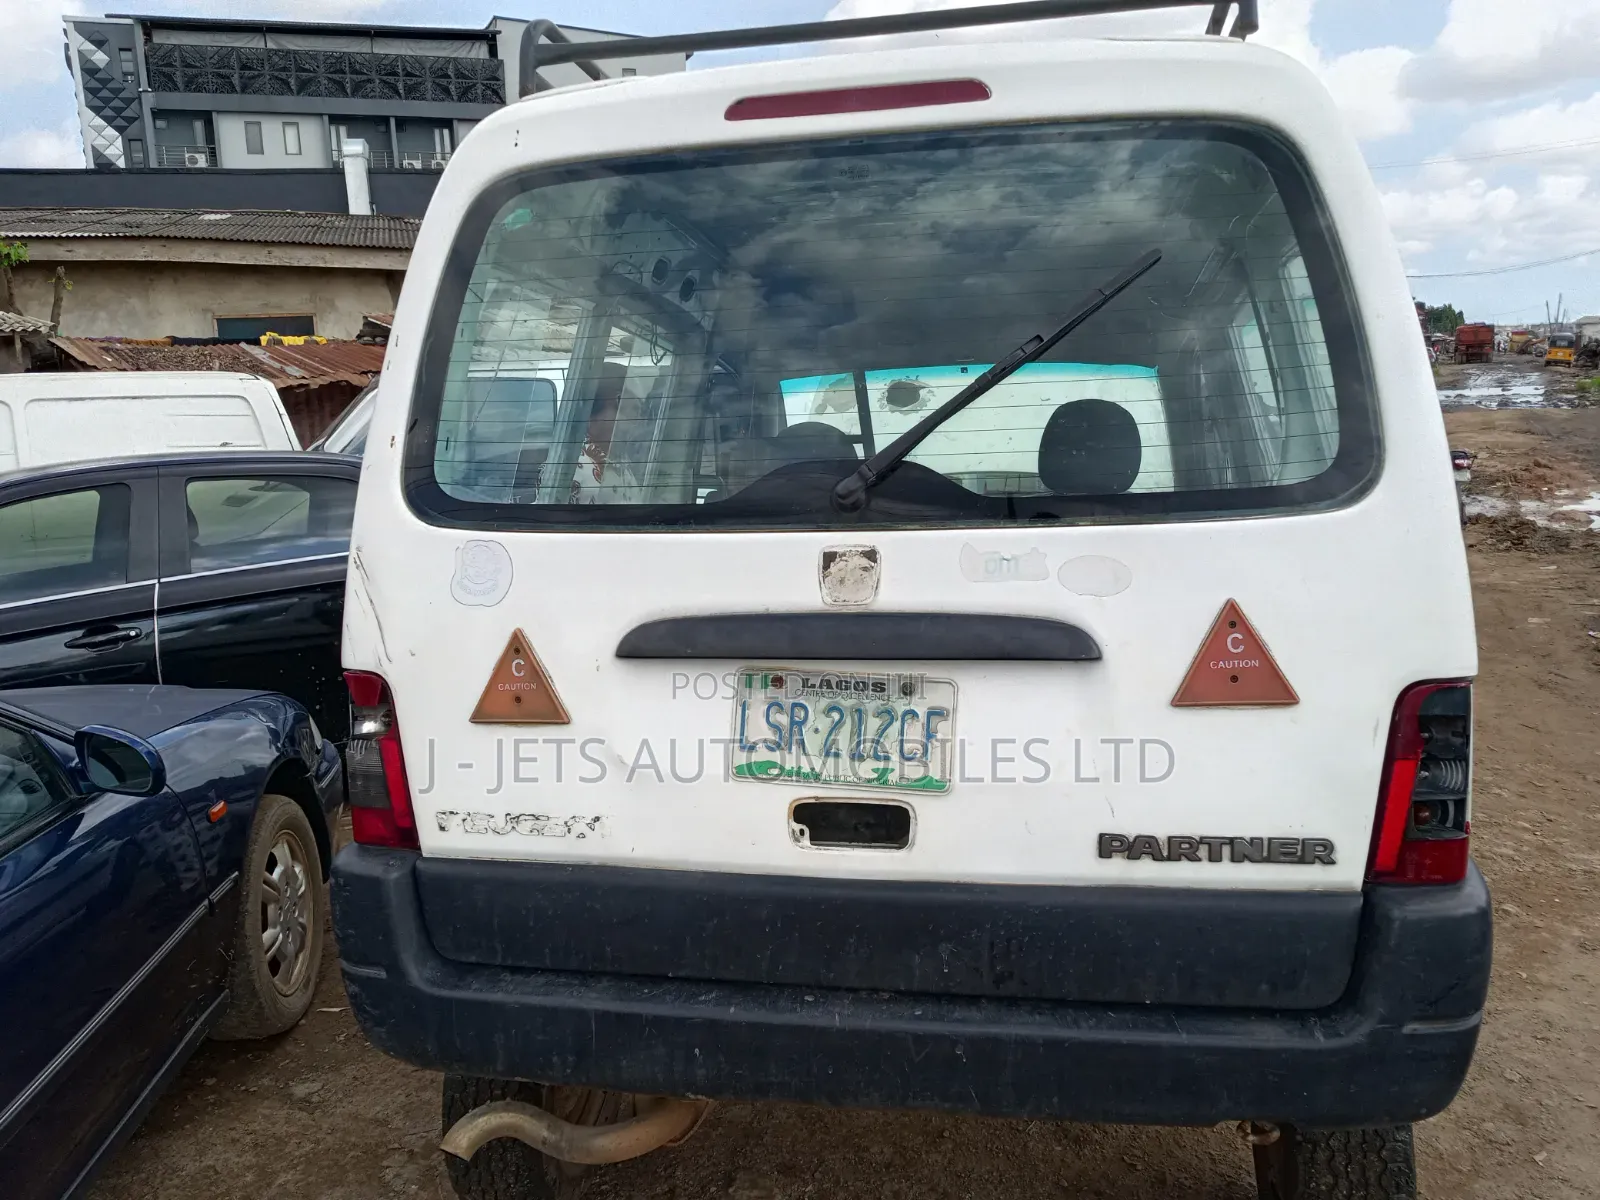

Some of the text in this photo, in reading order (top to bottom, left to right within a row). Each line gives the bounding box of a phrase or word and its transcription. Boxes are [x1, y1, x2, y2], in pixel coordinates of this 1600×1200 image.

[1226, 632, 1245, 654] C
[511, 658, 525, 677] C
[1209, 658, 1259, 669] CAUTION
[498, 682, 537, 691] CAUTION
[801, 677, 887, 693] LAGOS
[1098, 832, 1336, 865] PARTNER
